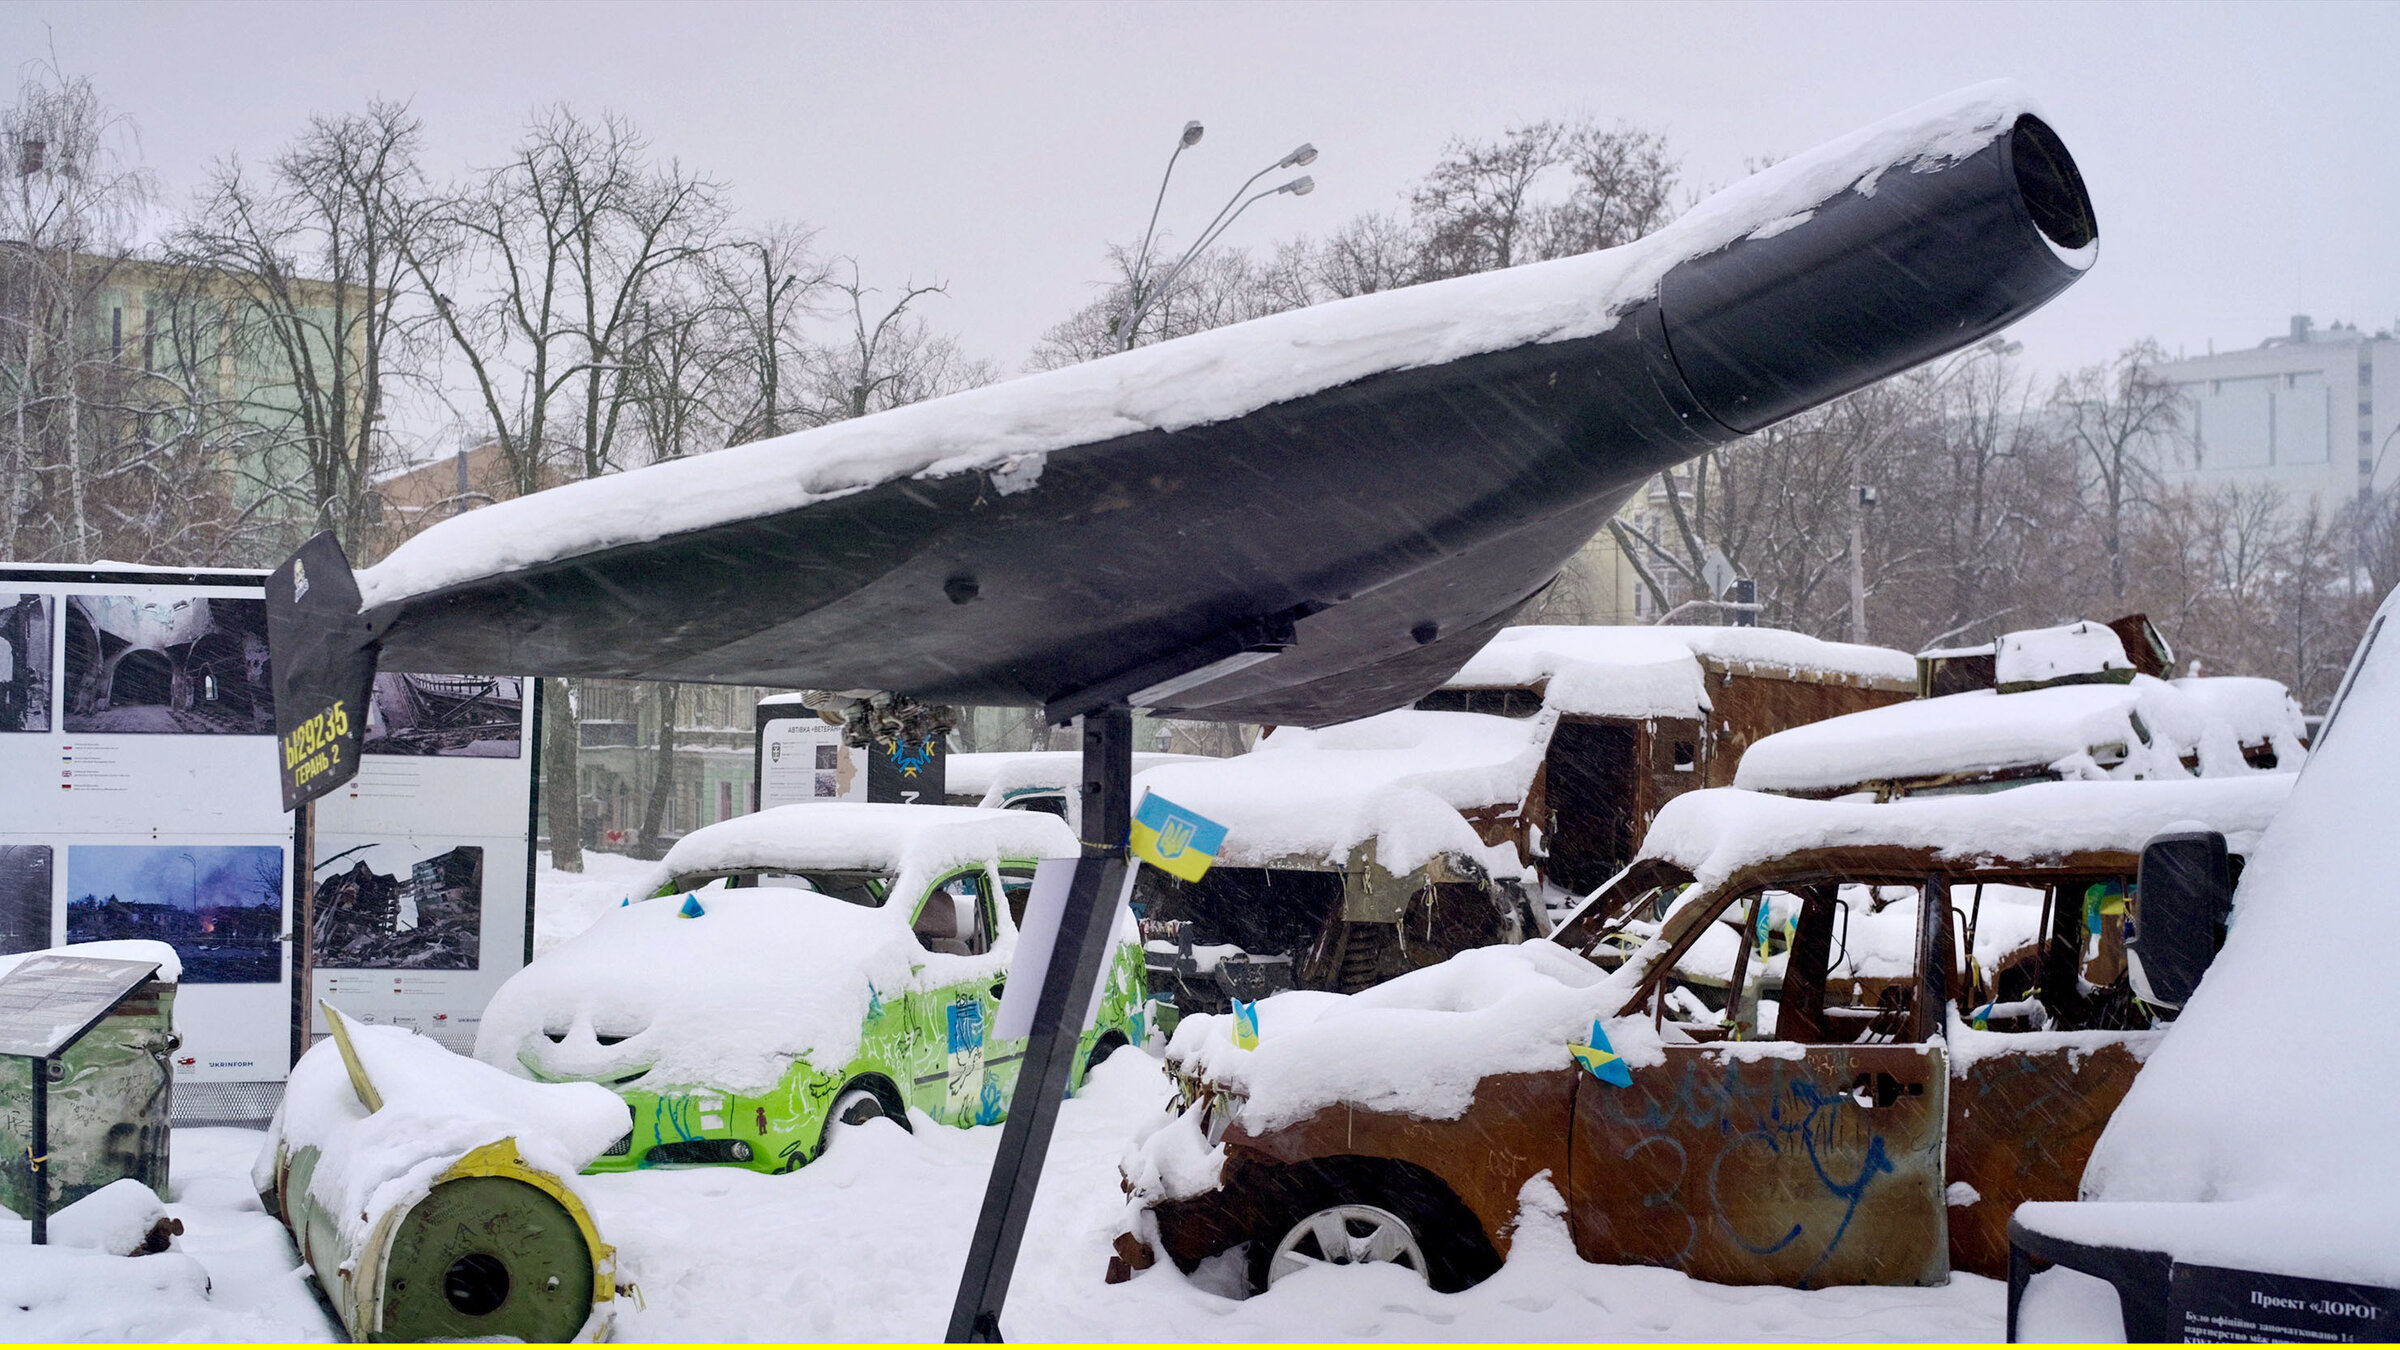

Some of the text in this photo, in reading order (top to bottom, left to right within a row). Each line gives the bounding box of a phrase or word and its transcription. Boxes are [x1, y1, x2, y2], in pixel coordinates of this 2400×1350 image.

[295, 744, 341, 787] ГЕРАНЬ 2
[2184, 1326, 2247, 1340] партнерство
[2185, 1311, 2210, 1323] Було
[2211, 1315, 2256, 1329] офіційно
[2259, 1323, 2338, 1341] започатковано
